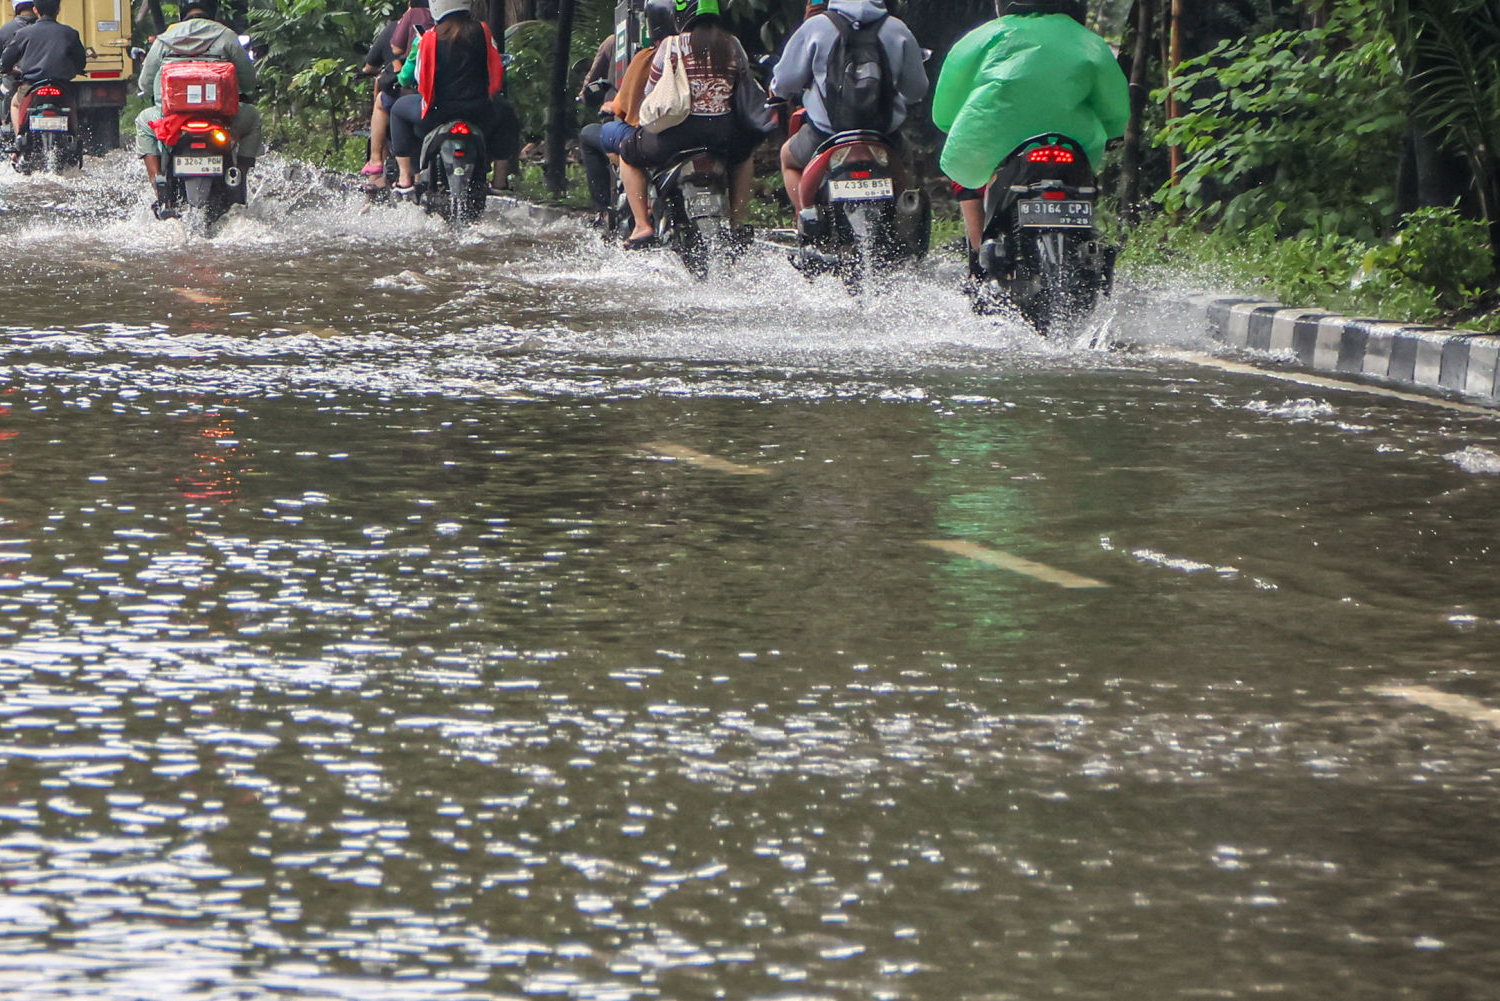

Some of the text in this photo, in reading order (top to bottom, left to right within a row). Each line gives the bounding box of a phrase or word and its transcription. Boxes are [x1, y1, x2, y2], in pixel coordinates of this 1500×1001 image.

[176, 158, 182, 166] B
[833, 179, 890, 190] B 4336 BSE
[1034, 203, 1062, 214] 3164
[1068, 203, 1089, 214] CPJ
